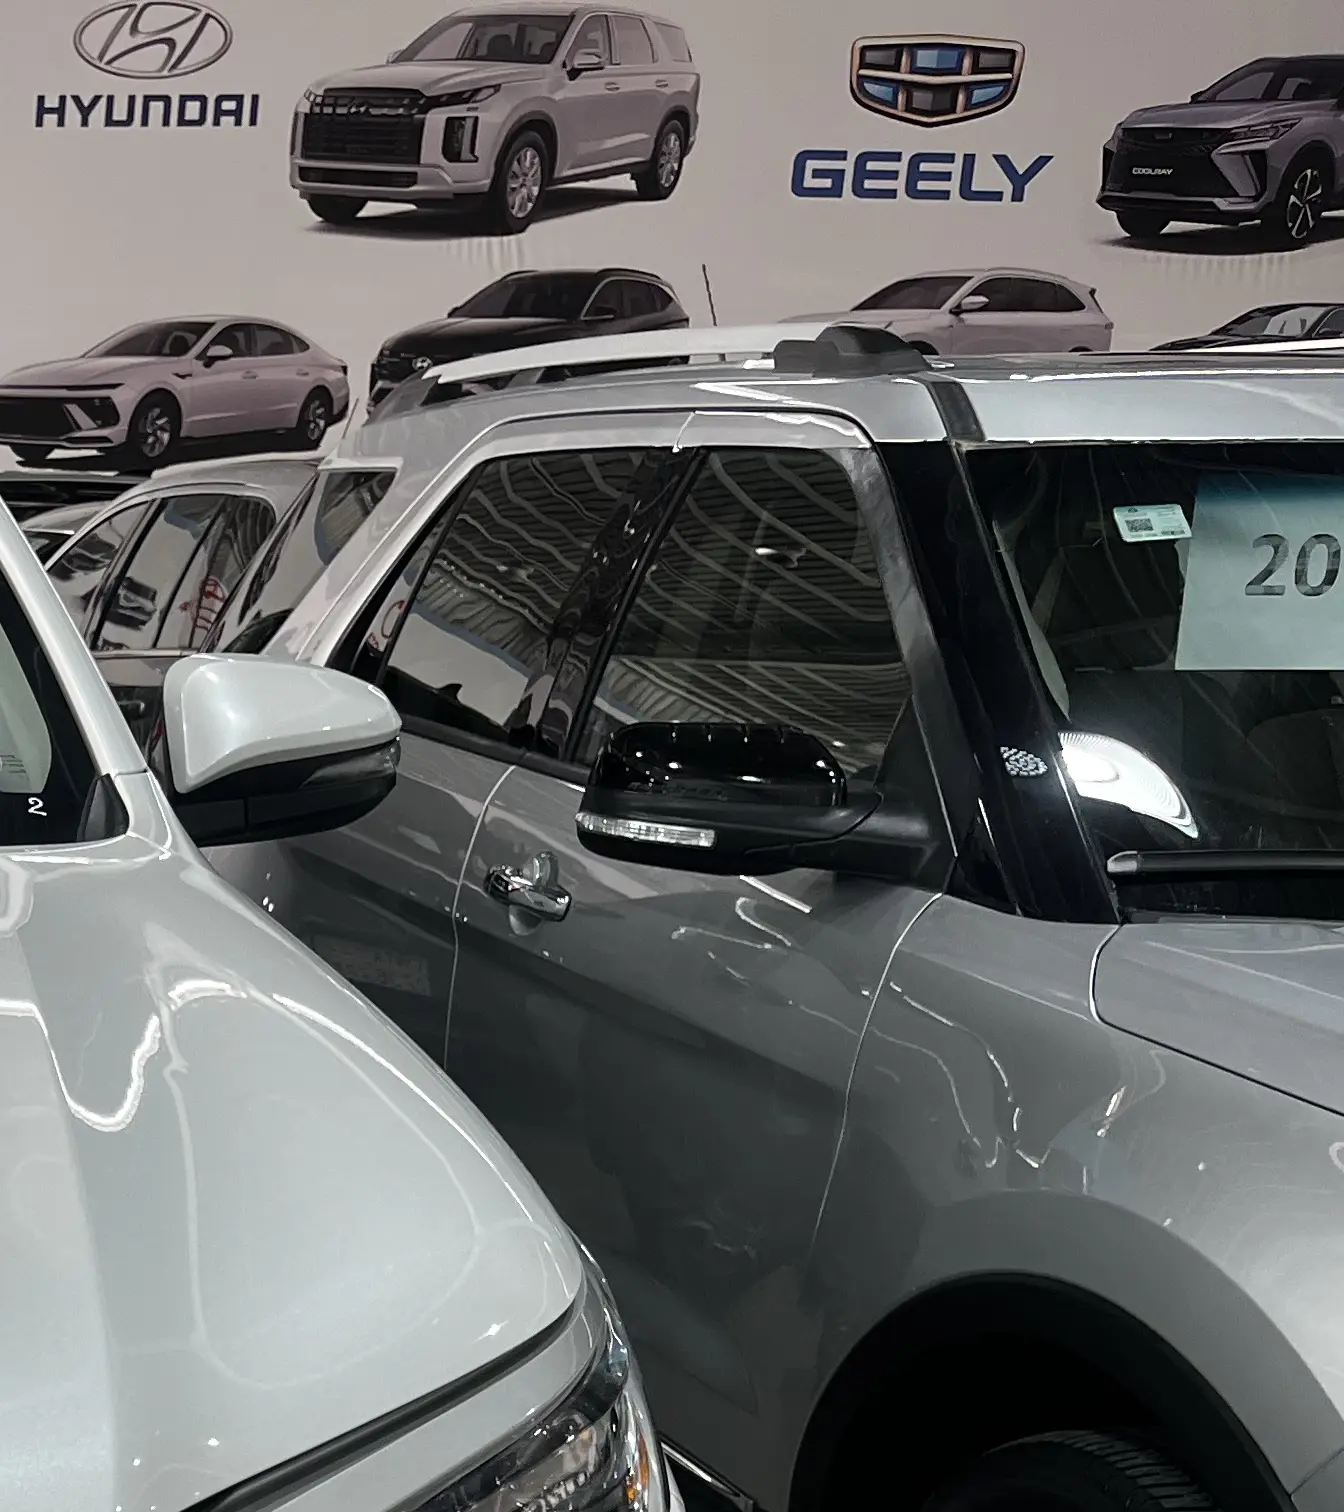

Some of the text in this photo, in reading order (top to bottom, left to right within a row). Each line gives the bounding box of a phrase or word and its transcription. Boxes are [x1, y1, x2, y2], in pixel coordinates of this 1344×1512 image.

[34, 93, 260, 128] HYUNDAI
[790, 148, 1054, 203] GEELY
[1132, 167, 1173, 175] COOLRAY
[27, 797, 47, 816] 2
